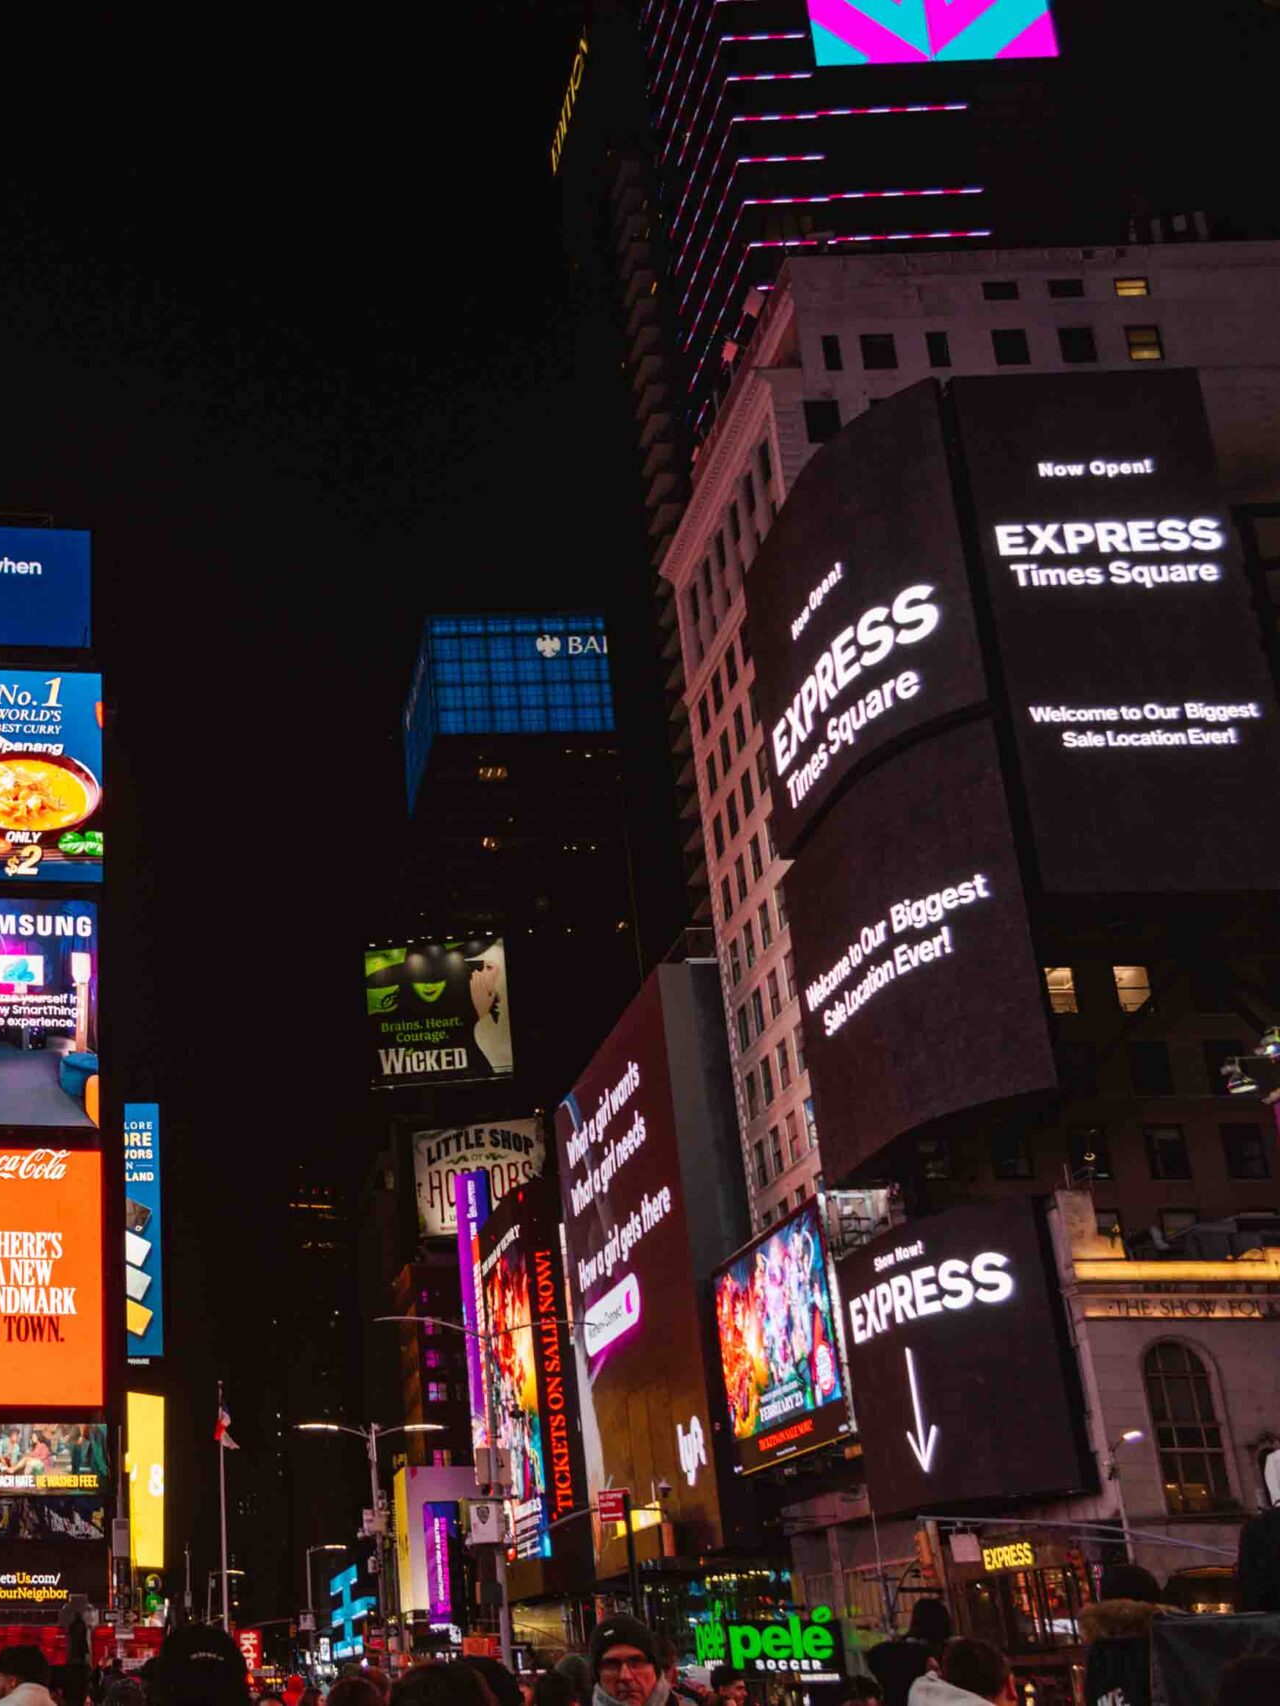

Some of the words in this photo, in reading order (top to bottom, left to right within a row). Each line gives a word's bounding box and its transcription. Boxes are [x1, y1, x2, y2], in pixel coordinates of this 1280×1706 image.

[1038, 462, 1085, 478] Now
[1089, 458, 1154, 478] Open!
[994, 517, 1224, 556] EXPRESS
[1009, 563, 1104, 587] Times
[1108, 560, 1220, 588] Square
[791, 606, 809, 641] Now
[809, 561, 845, 610] Open!
[567, 636, 608, 654] BA
[771, 584, 940, 776] EXPRESS
[1028, 705, 1118, 724] Welcome
[1119, 705, 1141, 721] to
[1143, 703, 1181, 720] Our
[1184, 701, 1261, 722] Biggest
[23, 724, 62, 735] CURRY
[787, 743, 828, 810] Times
[827, 670, 921, 754] Square
[1061, 732, 1106, 748] Sale
[1106, 729, 1186, 747] Location
[1187, 728, 1238, 744] Ever!
[5, 831, 42, 844] ONLY
[5, 844, 43, 876] $2
[805, 955, 851, 1012] Welcome
[849, 943, 864, 967] to
[860, 920, 887, 955] Our
[890, 873, 991, 934] Biggest
[823, 1001, 847, 1036] Sale
[844, 960, 895, 1016] Location
[893, 925, 954, 975] Ever!
[21, 992, 68, 1005] yourself
[7, 1017, 77, 1029] experience.
[381, 1019, 423, 1032] Brains.
[426, 1016, 464, 1028] Heart.
[396, 1030, 449, 1043] Courage.
[566, 1121, 590, 1169] What
[588, 1118, 596, 1144] a
[596, 1088, 613, 1143] girl
[610, 1060, 640, 1115] wants
[426, 1128, 485, 1167] LITTLE
[490, 1130, 535, 1155] SHOP
[571, 1170, 594, 1217] What
[593, 1166, 600, 1194] a
[600, 1139, 617, 1193] girl
[615, 1110, 647, 1168] needs
[428, 1161, 534, 1223] HOORS
[578, 1254, 598, 1293] How
[597, 1253, 606, 1278] a
[604, 1224, 621, 1278] girl
[620, 1210, 642, 1262] gets
[641, 1185, 671, 1234] there
[873, 1252, 895, 1272] Show
[894, 1240, 924, 1261] Now!
[10, 1259, 54, 1286] NEW
[534, 1250, 556, 1311] NOW!
[849, 1252, 1014, 1344] EXPRESS
[1115, 1299, 1154, 1316] THE
[1159, 1299, 1218, 1316] SHOW
[3, 1315, 65, 1342] TOWN.
[541, 1317, 561, 1373] SALE
[546, 1376, 564, 1411] ON
[550, 1411, 574, 1513] TICKETS
[36, 1475, 47, 1488] HE
[47, 1475, 78, 1488] WASHED
[79, 1475, 99, 1488] FEET.
[982, 1542, 1034, 1571] EXPRESS
[755, 1659, 822, 1671] SOCCER
